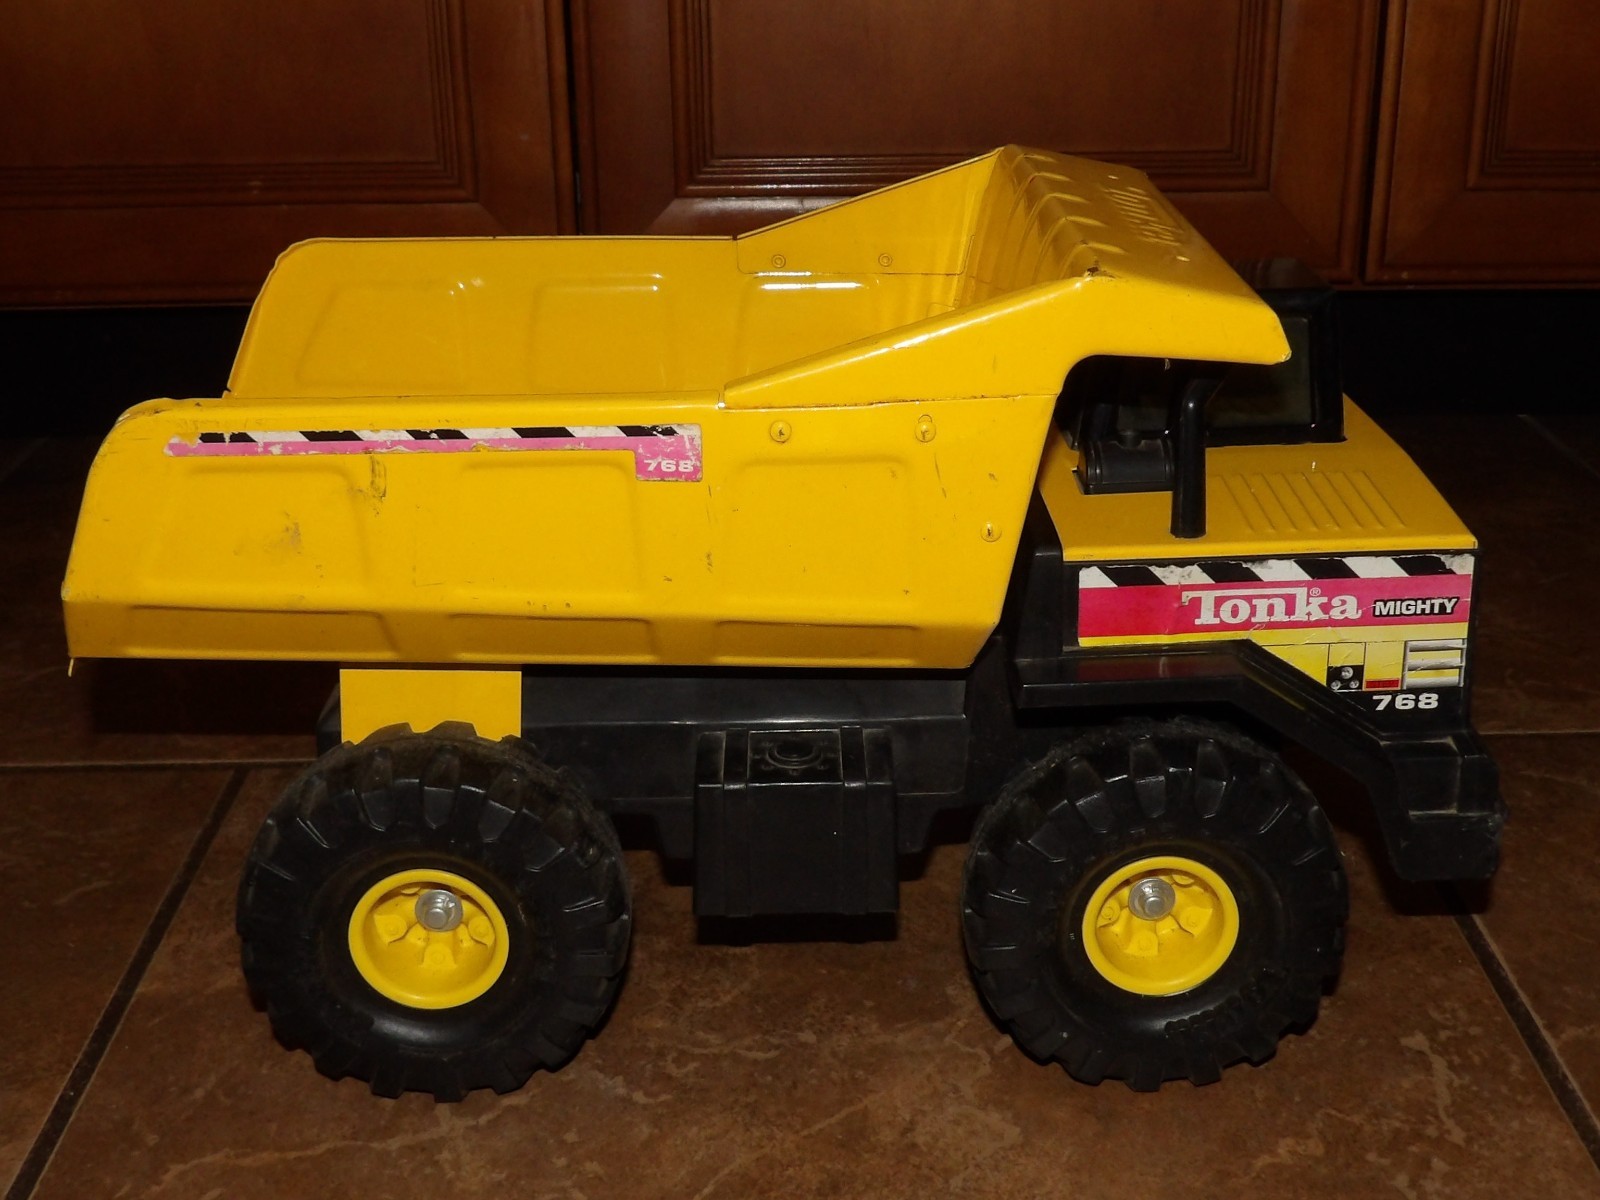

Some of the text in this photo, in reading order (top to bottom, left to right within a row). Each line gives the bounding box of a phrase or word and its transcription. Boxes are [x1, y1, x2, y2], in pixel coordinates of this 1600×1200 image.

[643, 459, 694, 472] 768
[1374, 598, 1458, 616] MIGHTY
[1372, 693, 1439, 711] 768
